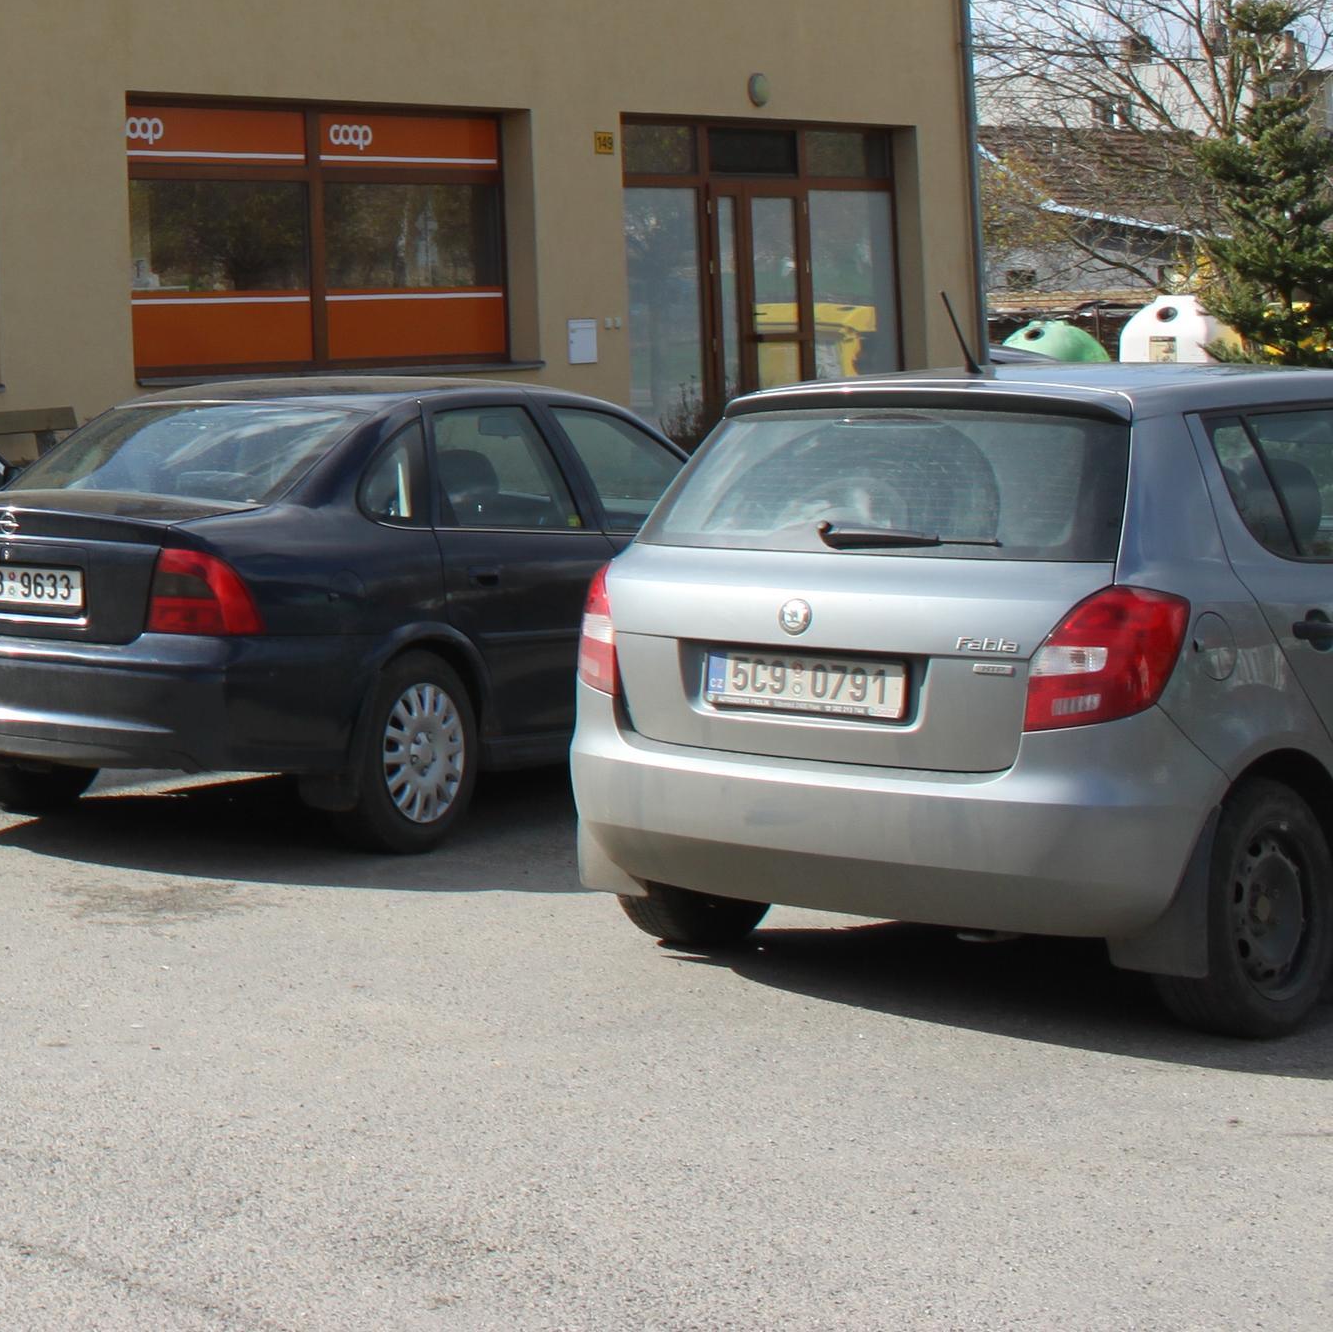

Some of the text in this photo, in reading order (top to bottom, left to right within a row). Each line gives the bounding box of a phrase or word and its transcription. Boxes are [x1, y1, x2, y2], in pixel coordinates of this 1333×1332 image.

[125, 117, 164, 145] oop
[329, 124, 373, 151] coop
[20, 571, 72, 601] 9633
[955, 635, 1019, 653] Fabia
[710, 656, 886, 705] CZ 5C9 0791
